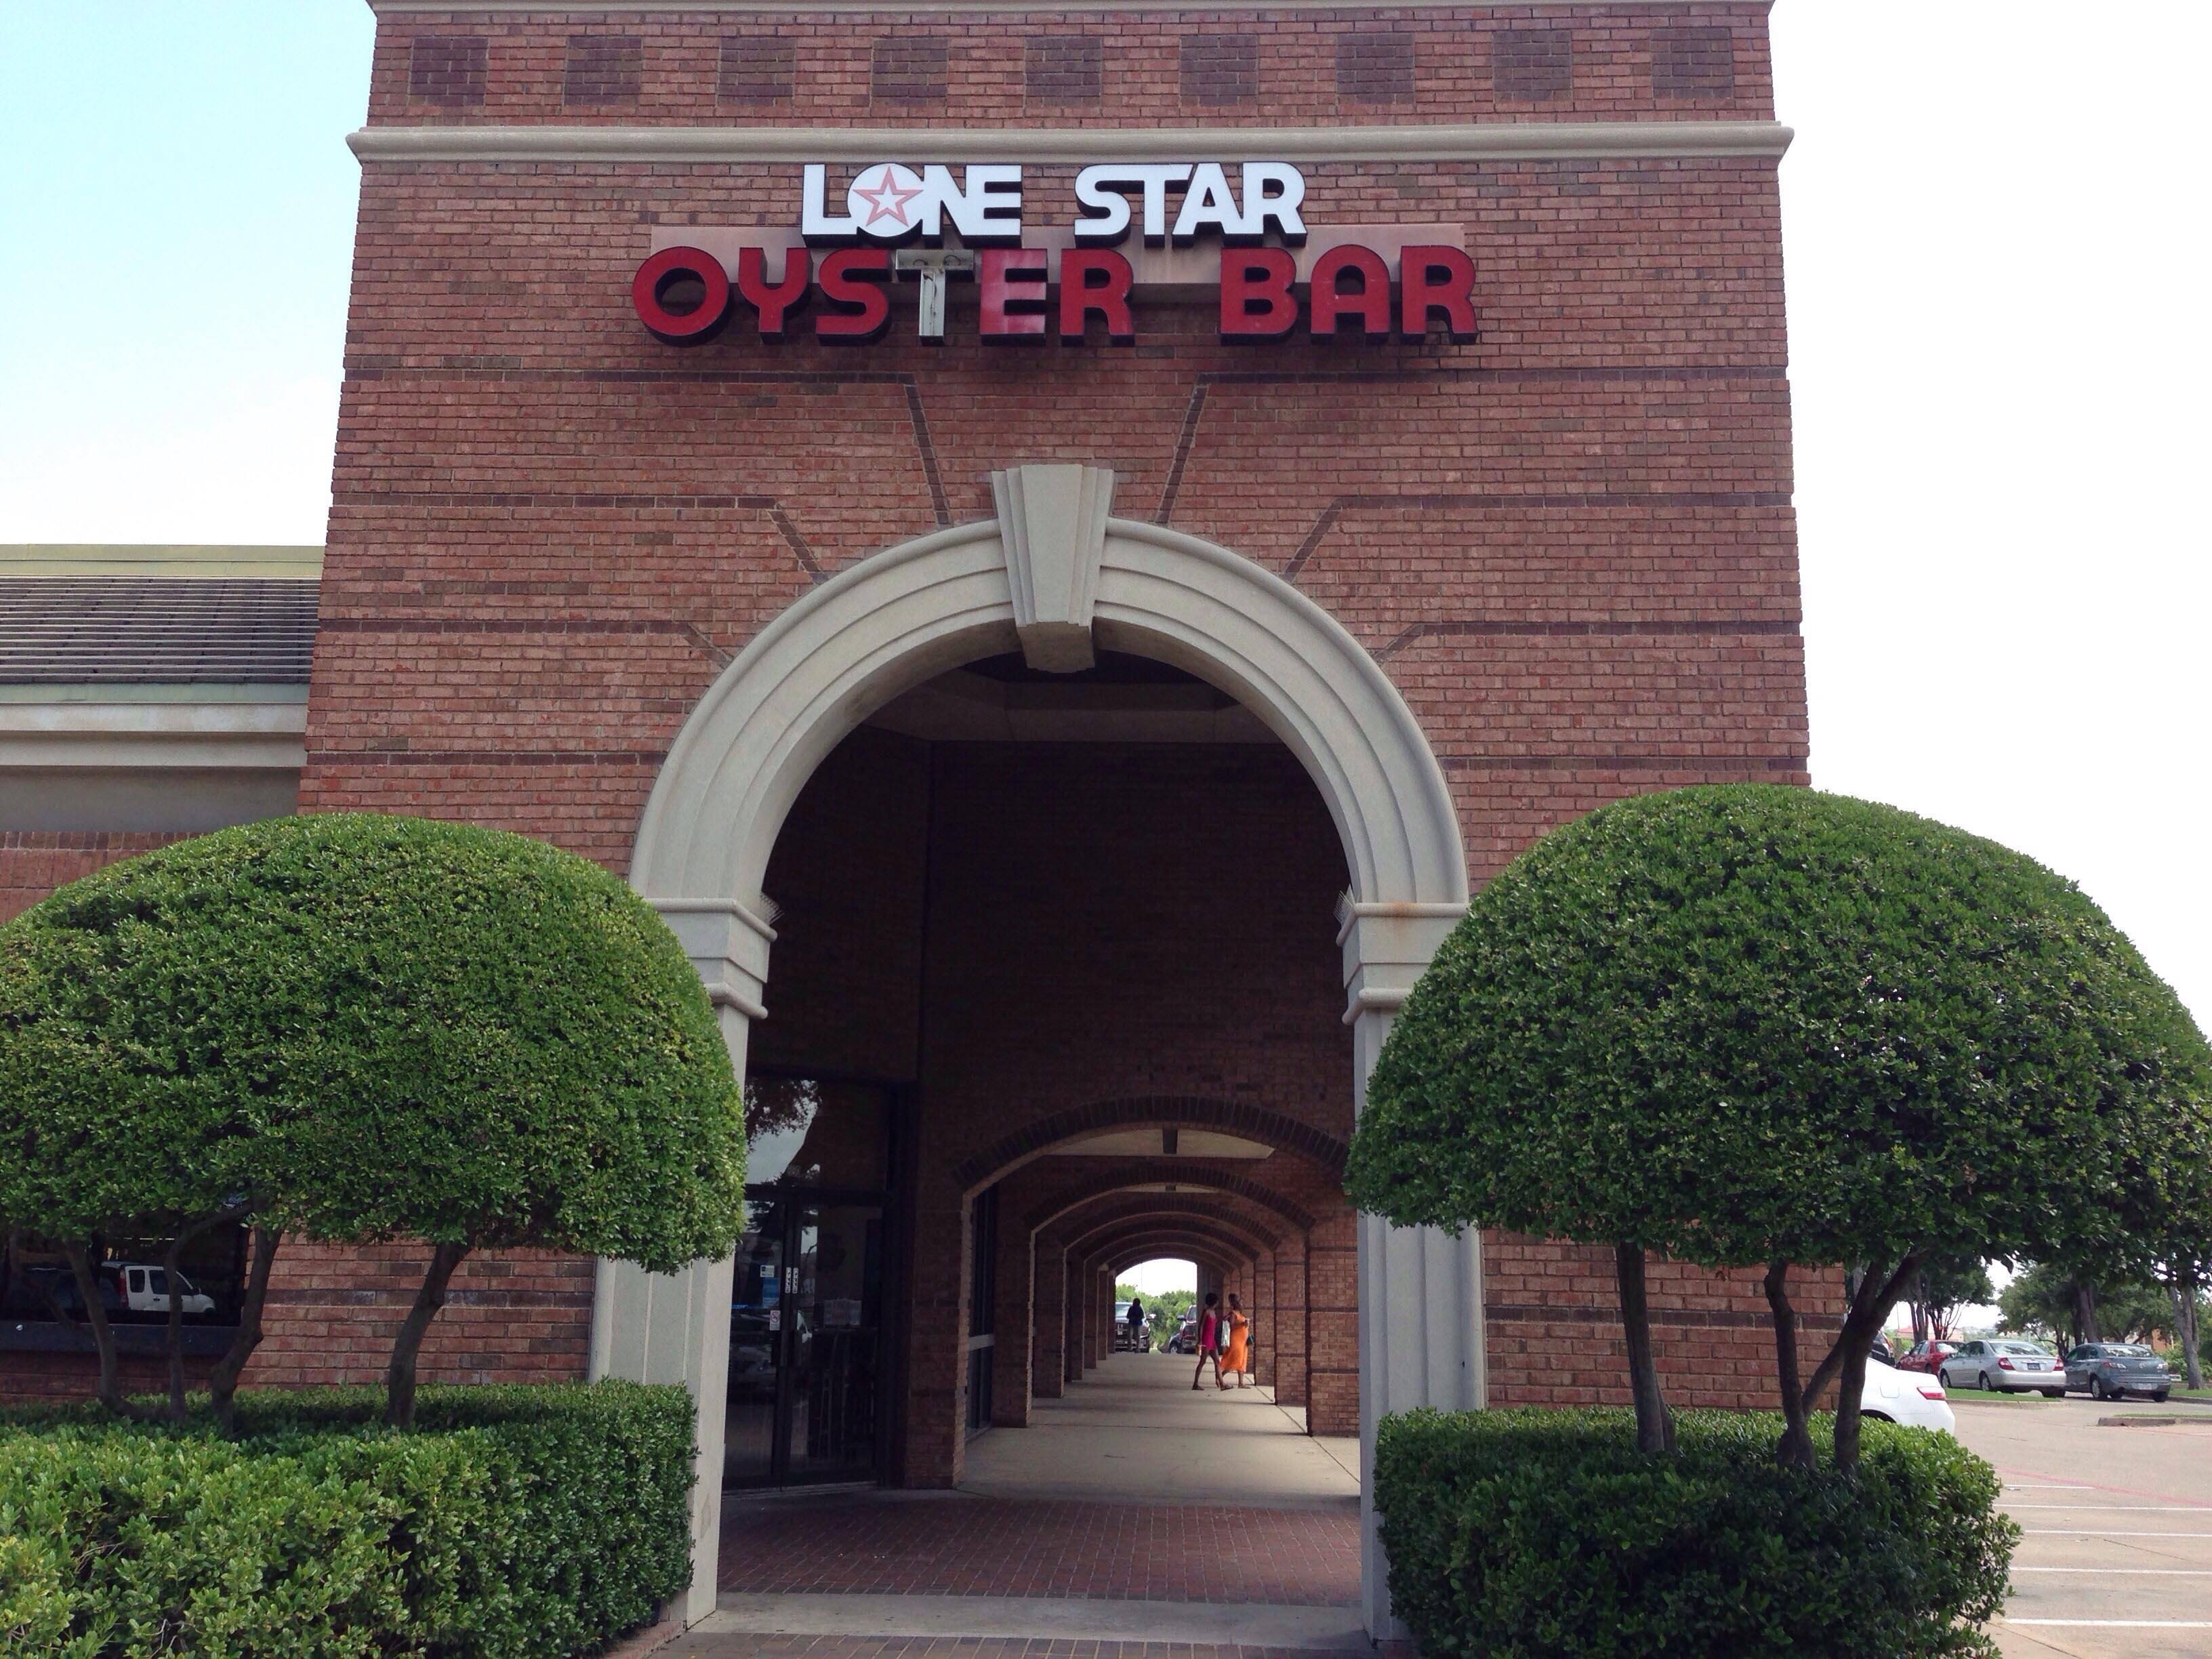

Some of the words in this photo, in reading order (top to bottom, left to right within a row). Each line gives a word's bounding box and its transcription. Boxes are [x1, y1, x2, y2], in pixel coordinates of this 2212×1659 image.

[802, 162, 1023, 245] LONE
[1073, 161, 1309, 245] STAR
[631, 246, 1136, 347] OYSTER
[1220, 244, 1479, 344] BAR
